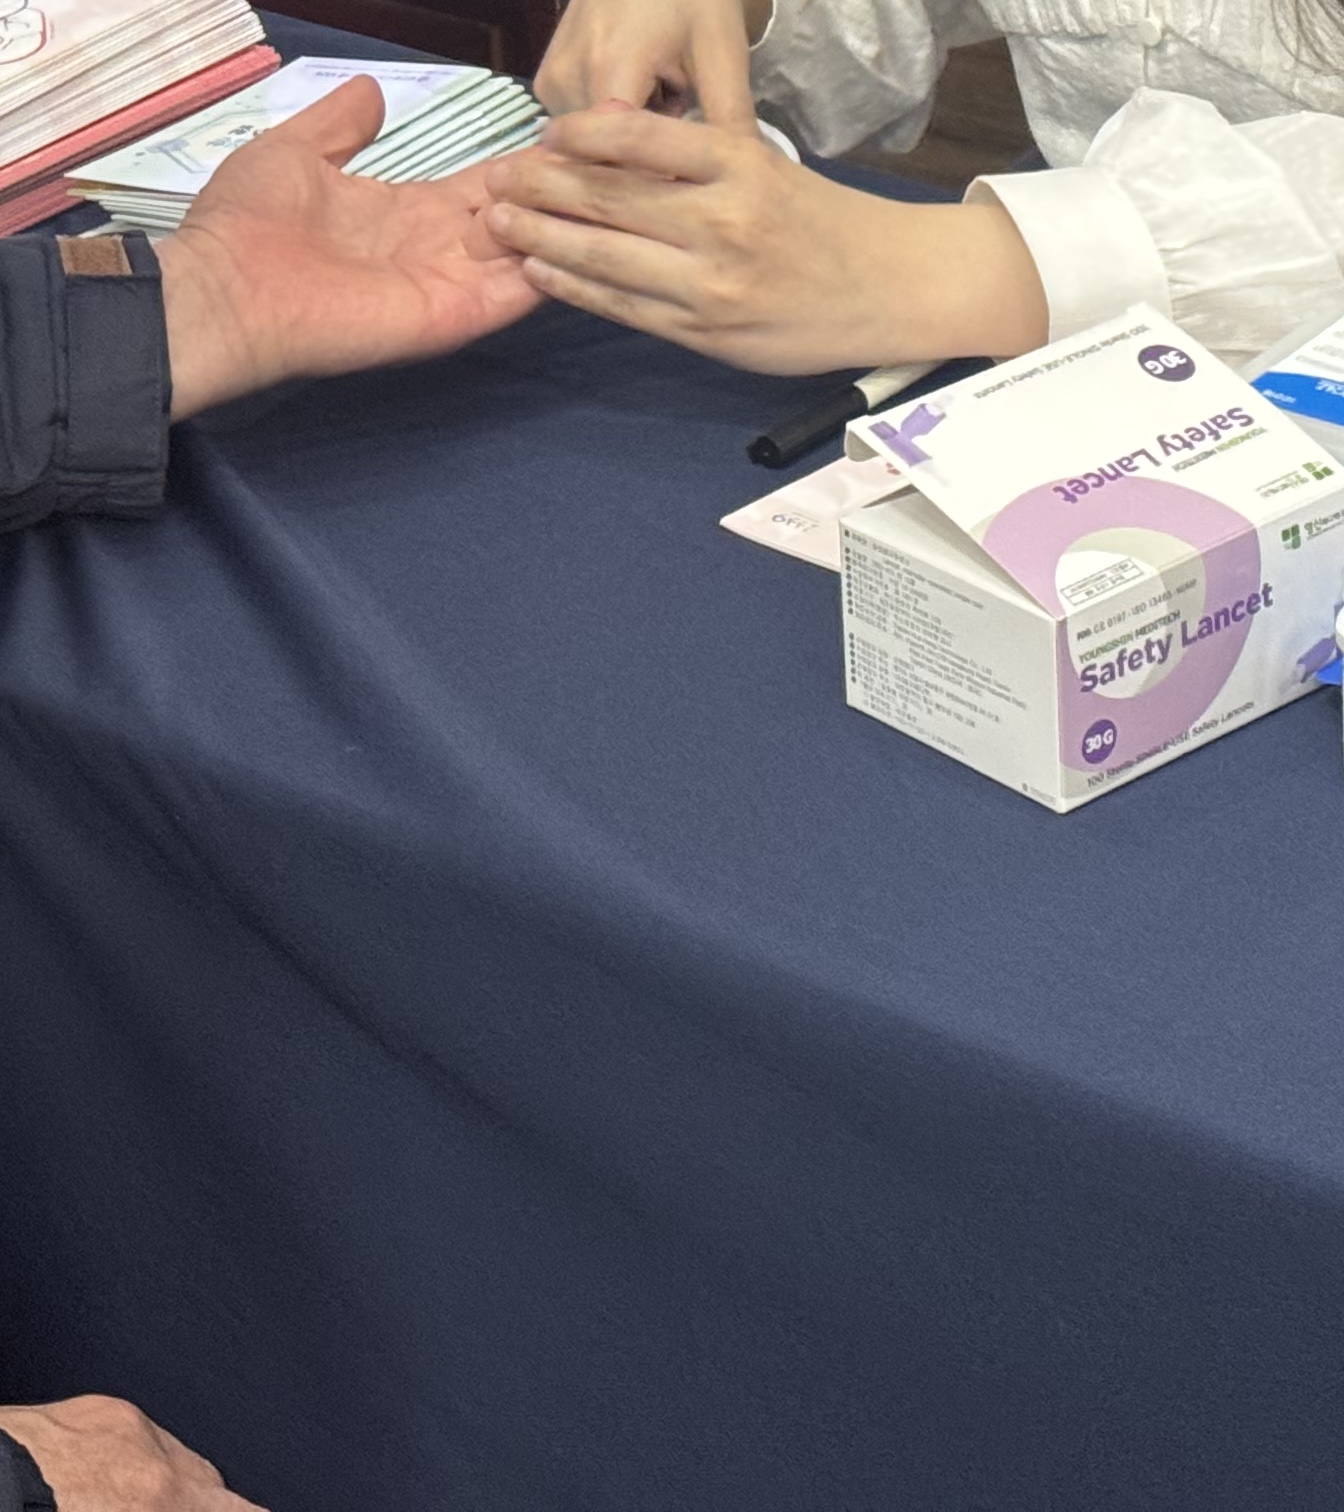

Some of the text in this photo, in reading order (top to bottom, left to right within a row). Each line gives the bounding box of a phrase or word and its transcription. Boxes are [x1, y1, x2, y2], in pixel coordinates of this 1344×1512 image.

[1052, 407, 1255, 505] Safety Lancet
[1080, 635, 1173, 693] Safety
[1181, 582, 1273, 649] Lancet
